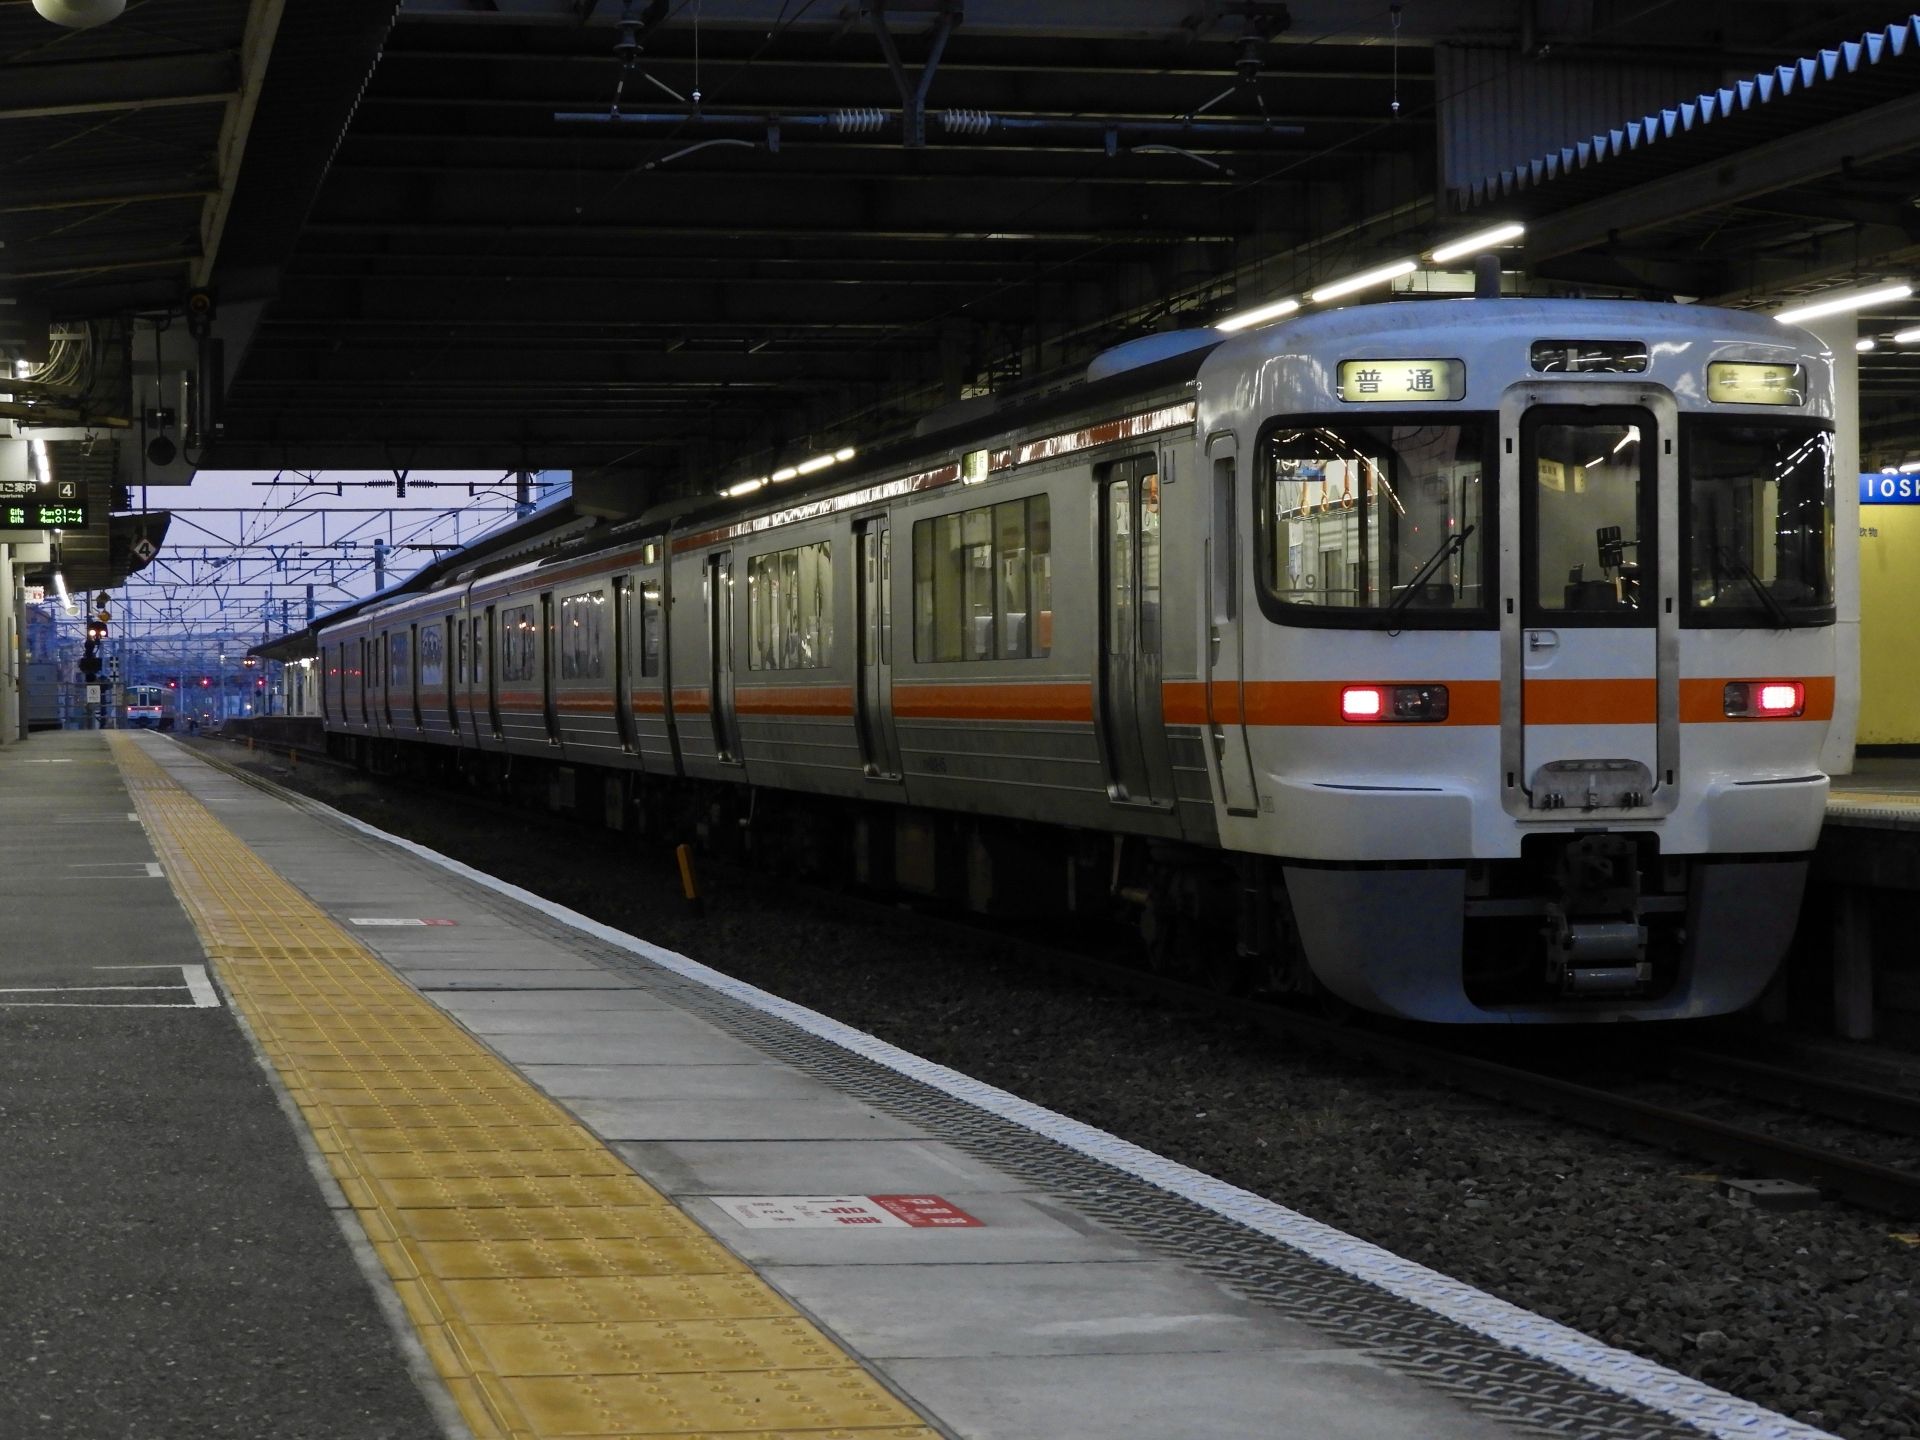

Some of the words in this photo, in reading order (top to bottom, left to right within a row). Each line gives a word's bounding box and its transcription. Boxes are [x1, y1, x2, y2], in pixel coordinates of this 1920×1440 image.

[1355, 369, 1435, 393] 普通
[0, 482, 37, 493] ご案内
[62, 484, 72, 496] 4
[138, 542, 151, 557] 4
